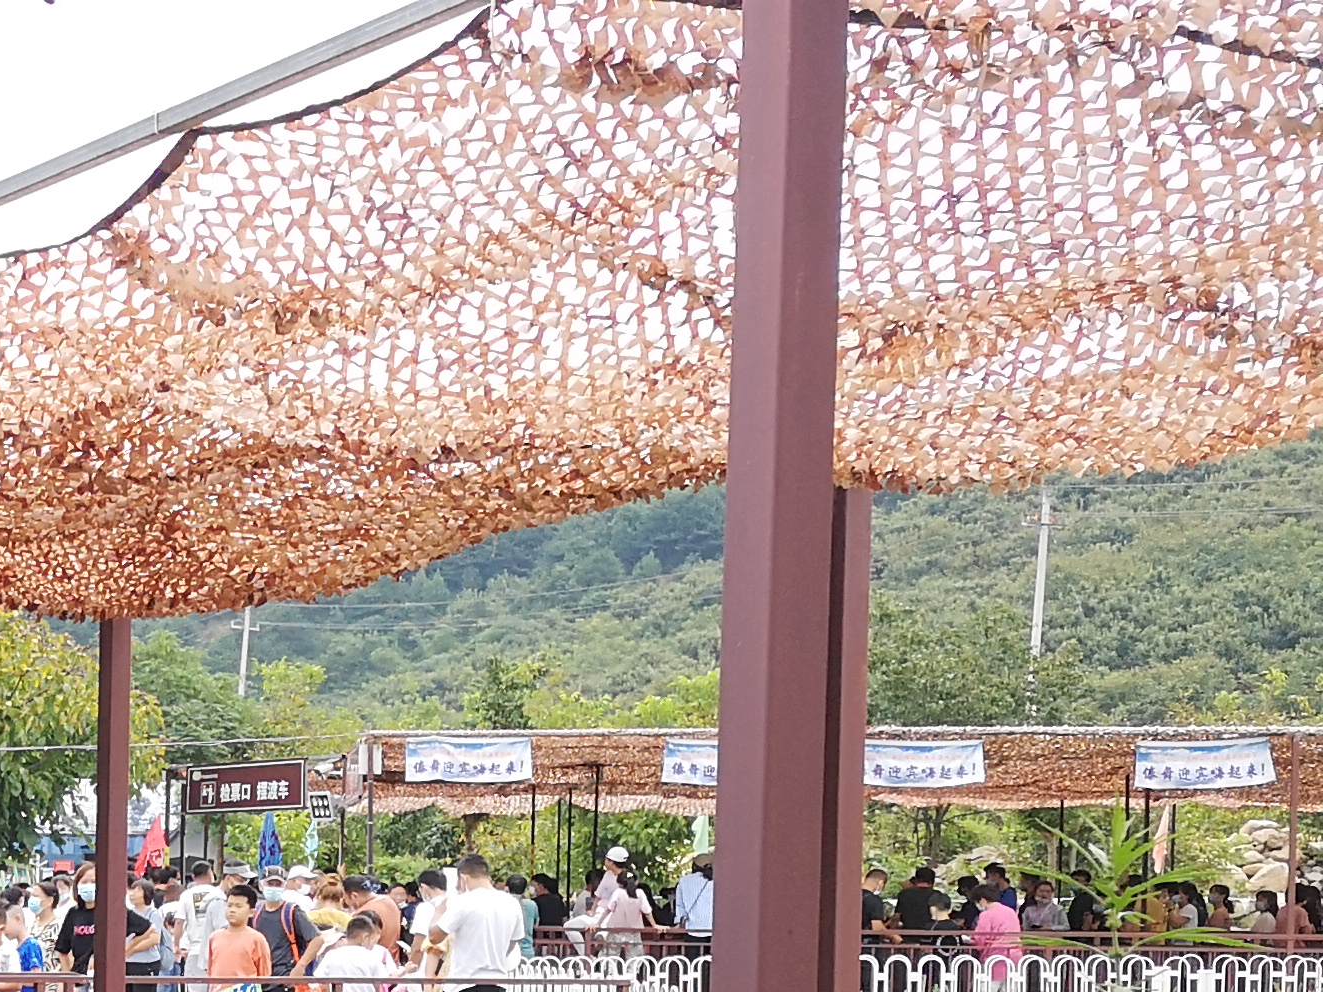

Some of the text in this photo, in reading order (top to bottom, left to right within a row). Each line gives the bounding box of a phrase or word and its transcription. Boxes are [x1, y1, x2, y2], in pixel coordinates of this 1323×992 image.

[863, 762, 978, 781] 舞迎宾嗨起来！
[219, 782, 252, 803] 检票口
